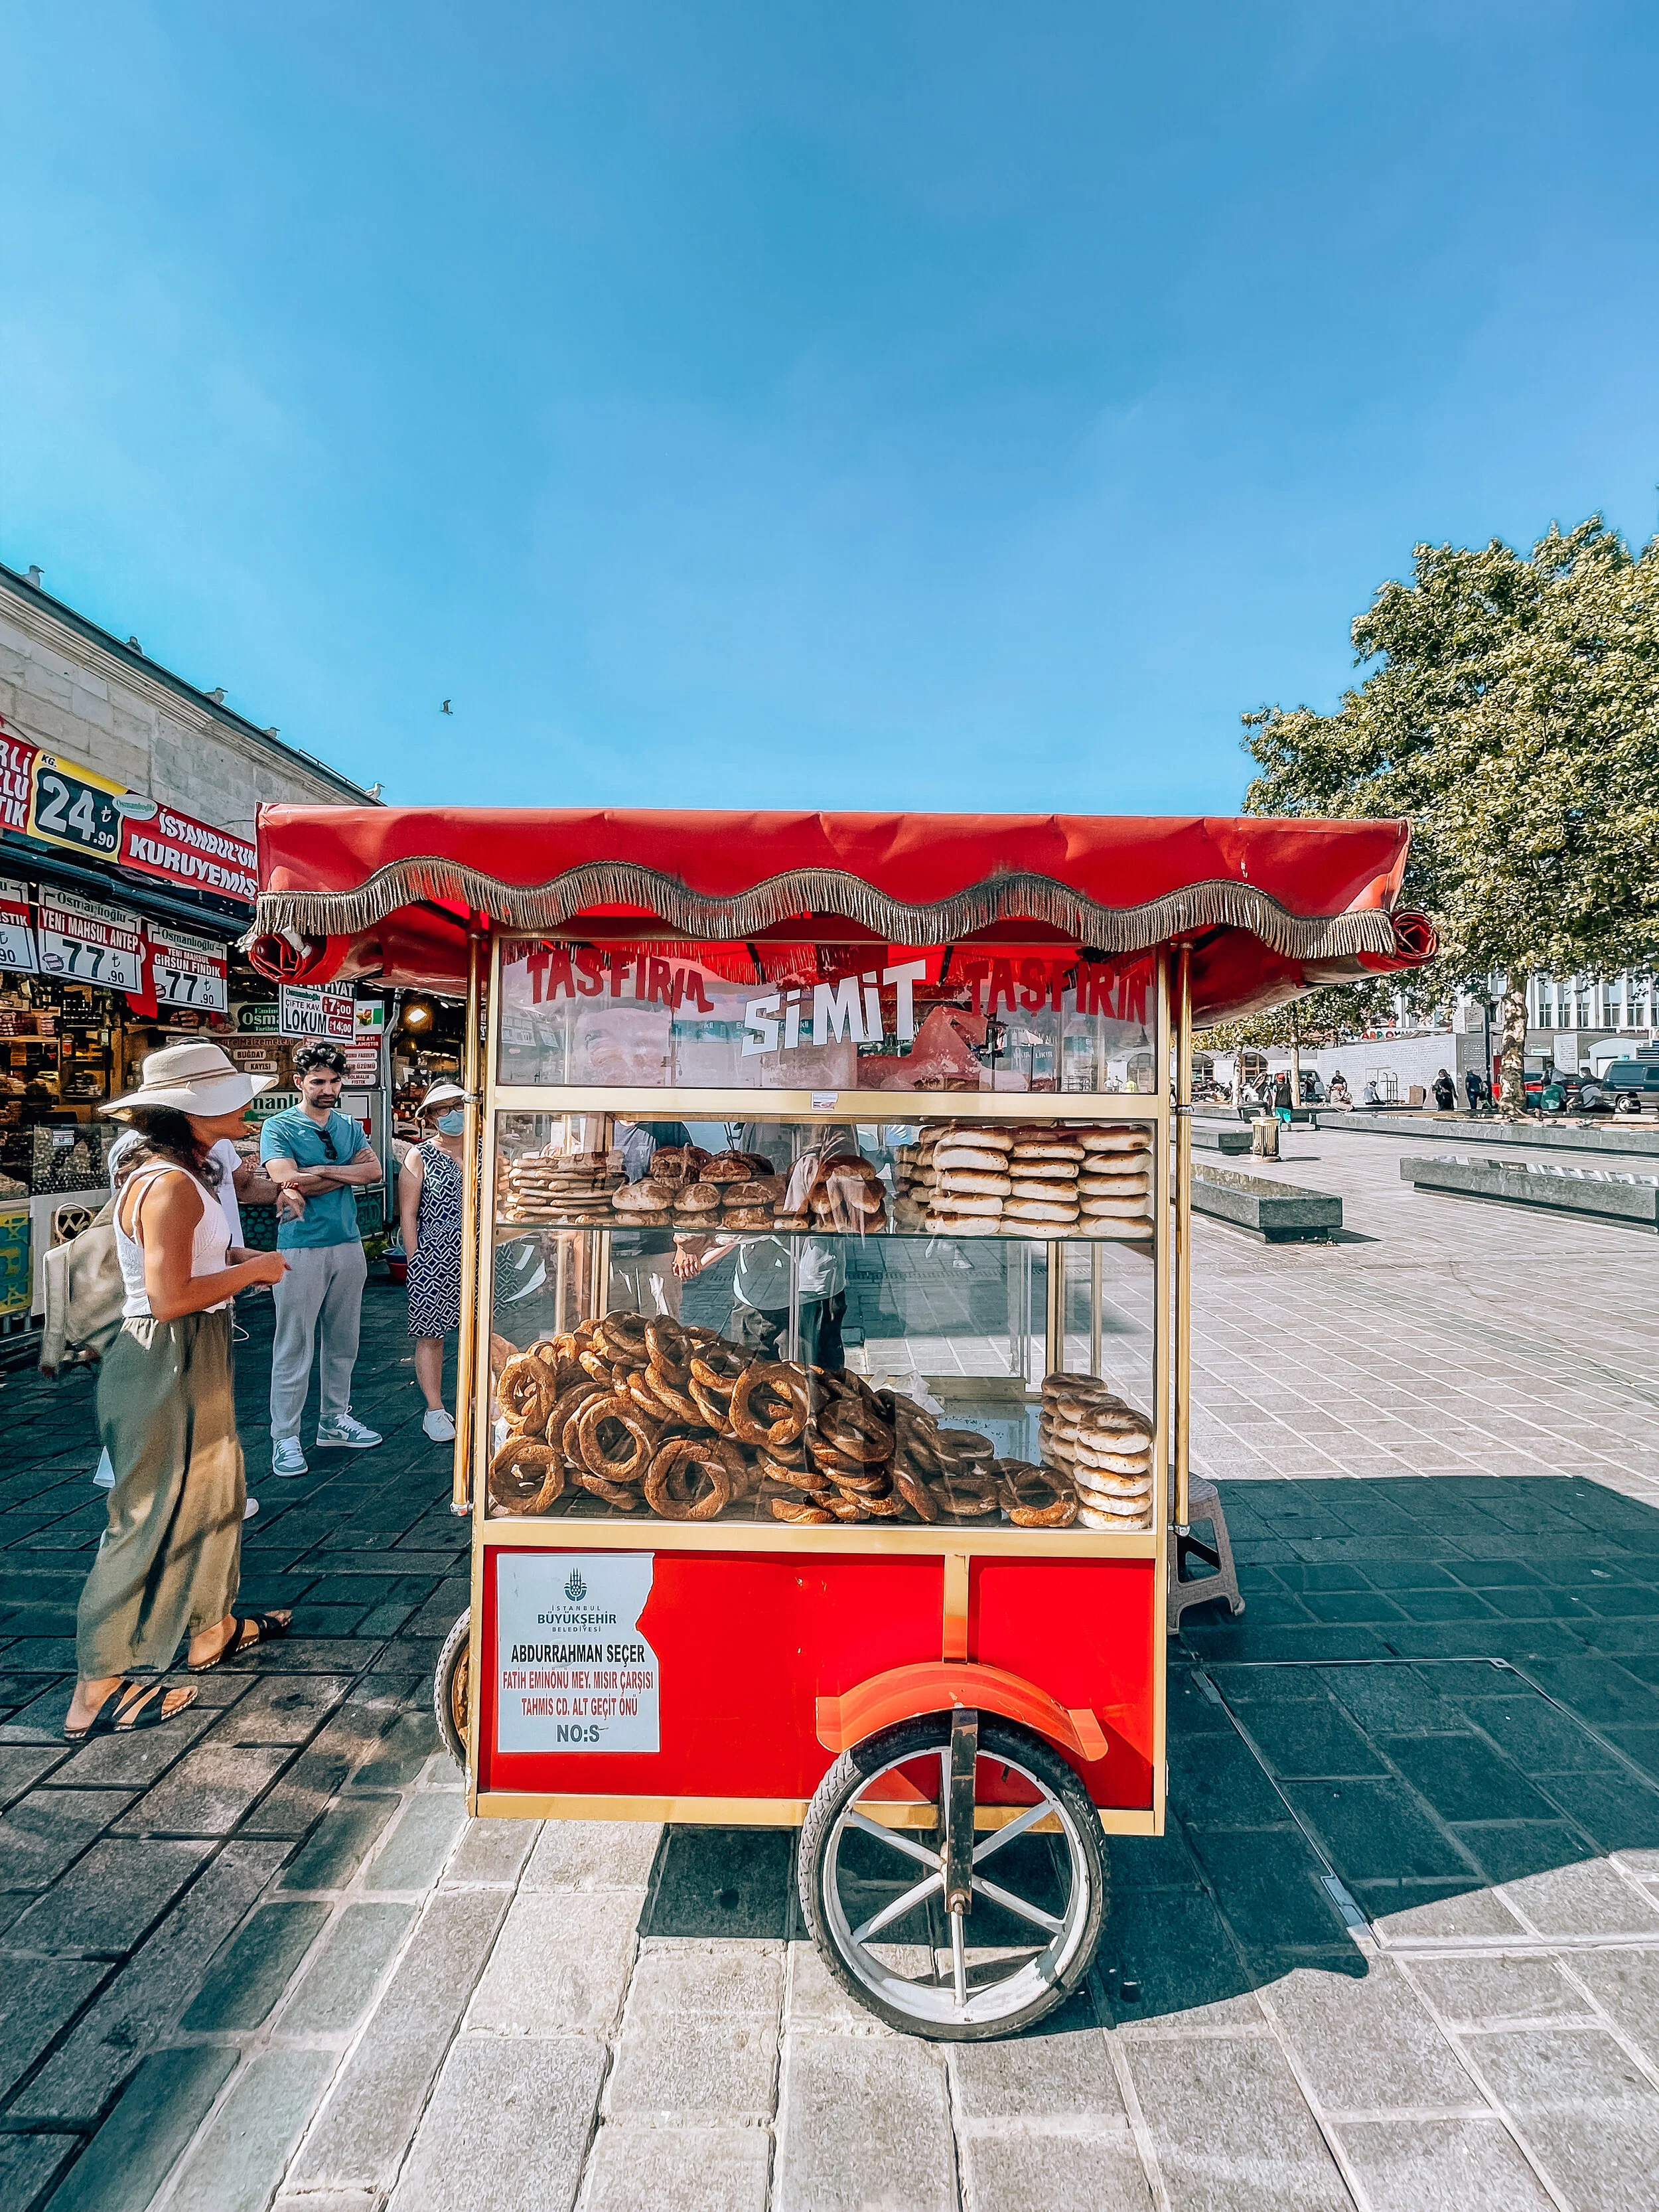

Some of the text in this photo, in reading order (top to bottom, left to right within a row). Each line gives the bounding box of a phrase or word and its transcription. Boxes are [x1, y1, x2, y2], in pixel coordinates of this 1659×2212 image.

[0, 768, 29, 801] LU
[129, 834, 258, 901] KURUYEMİŞ
[0, 911, 29, 926] STIK
[68, 917, 108, 944] MAHSUL
[110, 929, 139, 952] ANTEP
[191, 961, 221, 978] FINDIK
[285, 1007, 326, 1034] LOKUM
[237, 1049, 264, 1059] BUĞDAY
[538, 1611, 616, 1626] BÜYÜKŞEHİR
[511, 1644, 645, 1667] ABDURRAHMAN SEÇER
[503, 1667, 654, 1694] FATİH EMİNÖNÜ MEY. MISIR ÇARŞISI
[522, 1693, 638, 1720] TAHMİS CD. ALT GEÇİT ÖNÜ
